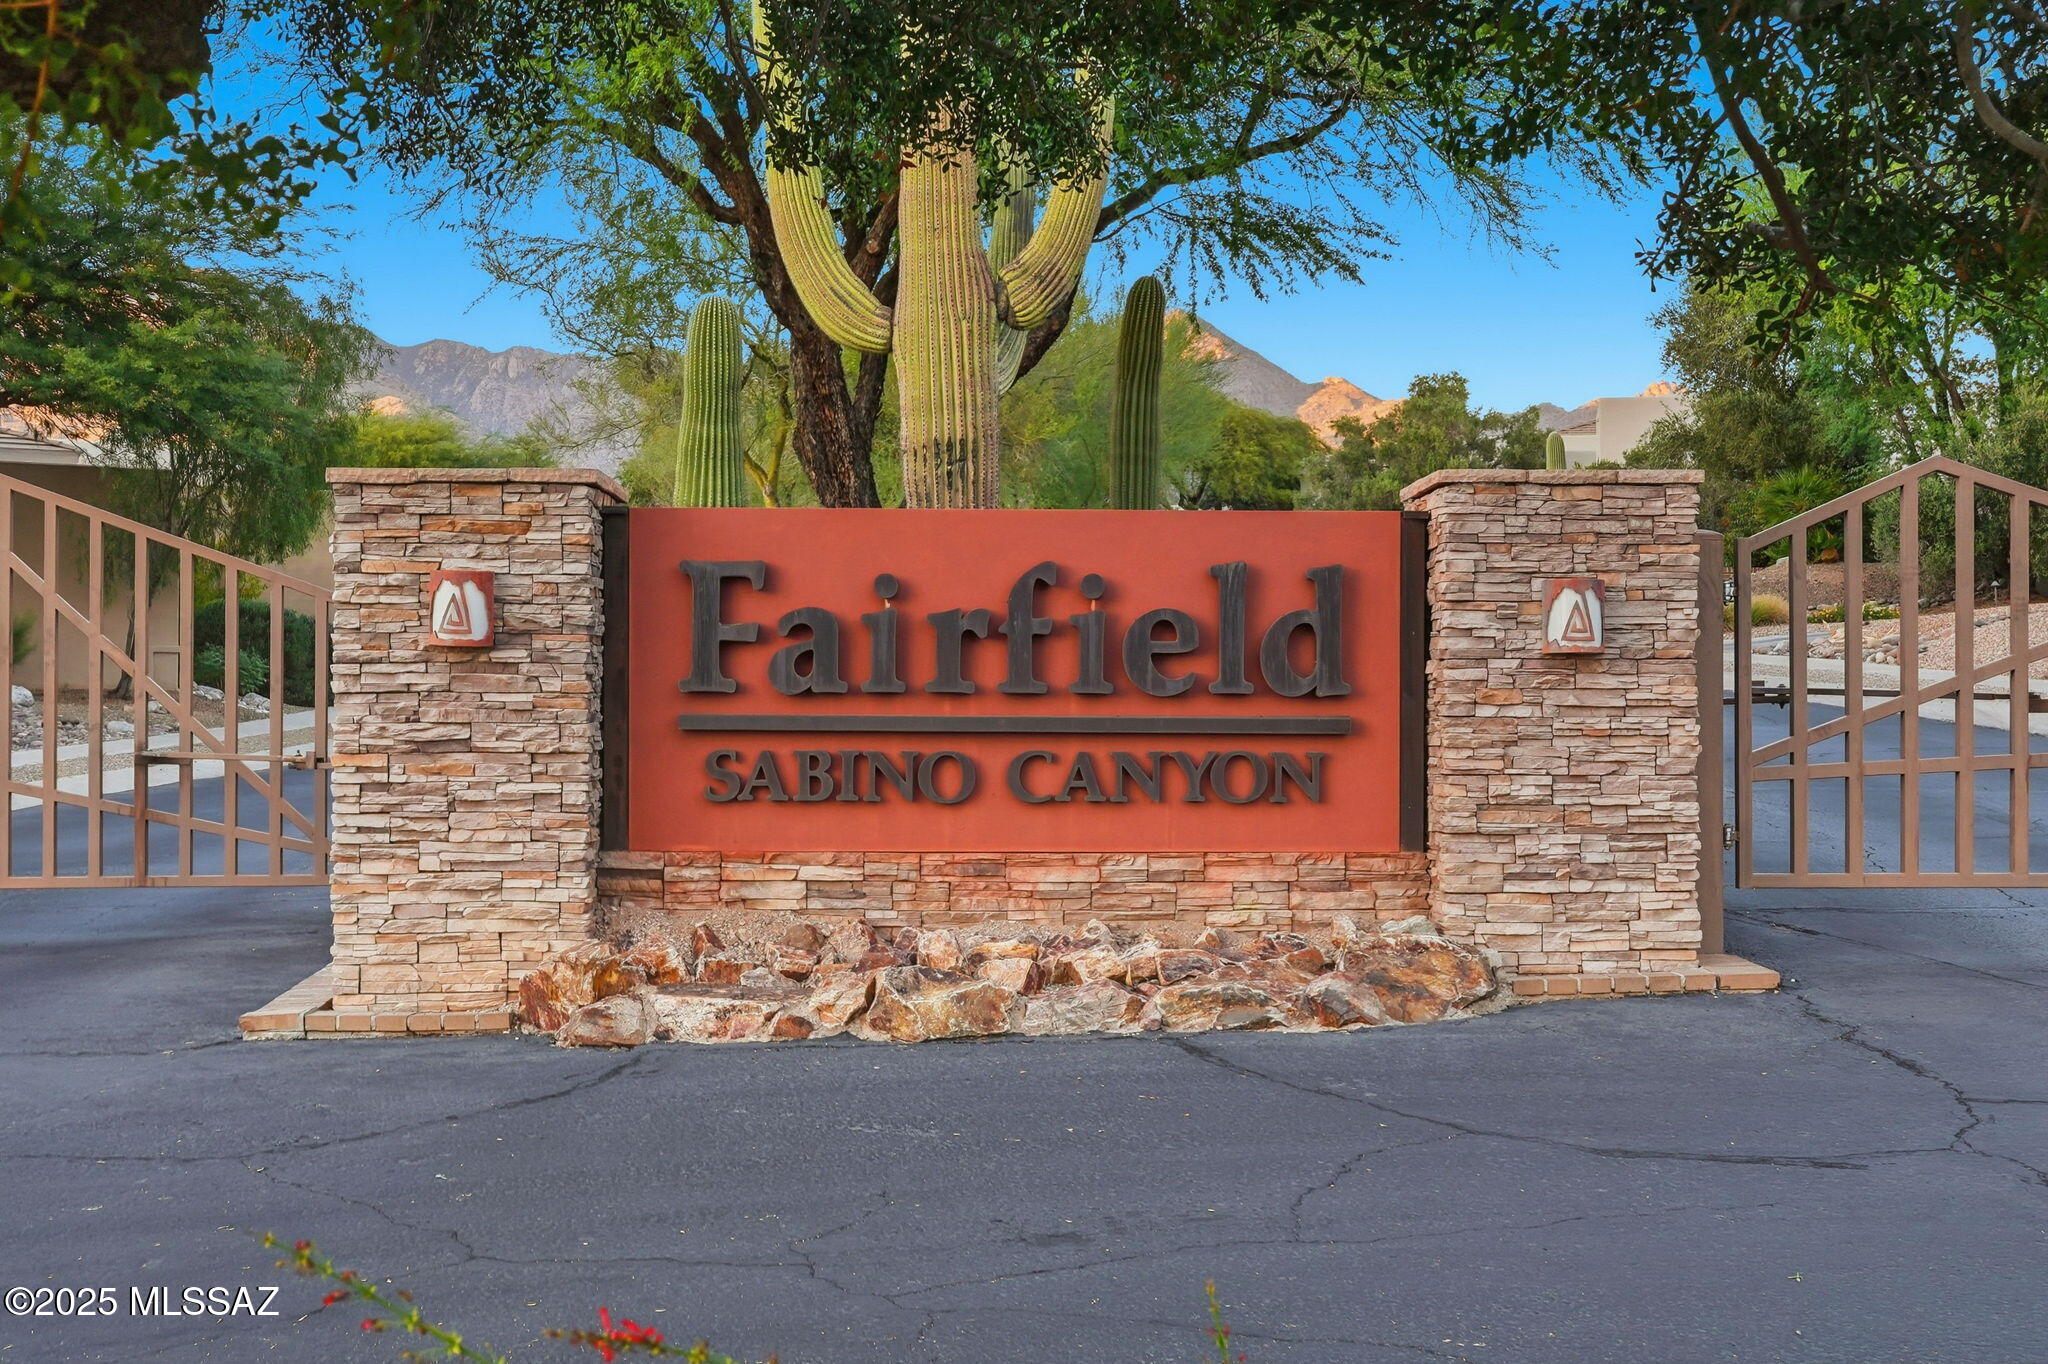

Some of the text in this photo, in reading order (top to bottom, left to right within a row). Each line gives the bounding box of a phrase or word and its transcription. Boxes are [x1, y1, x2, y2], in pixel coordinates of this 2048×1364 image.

[678, 560, 1351, 697] Fairfield
[703, 749, 1326, 804] SABINO CANYON
